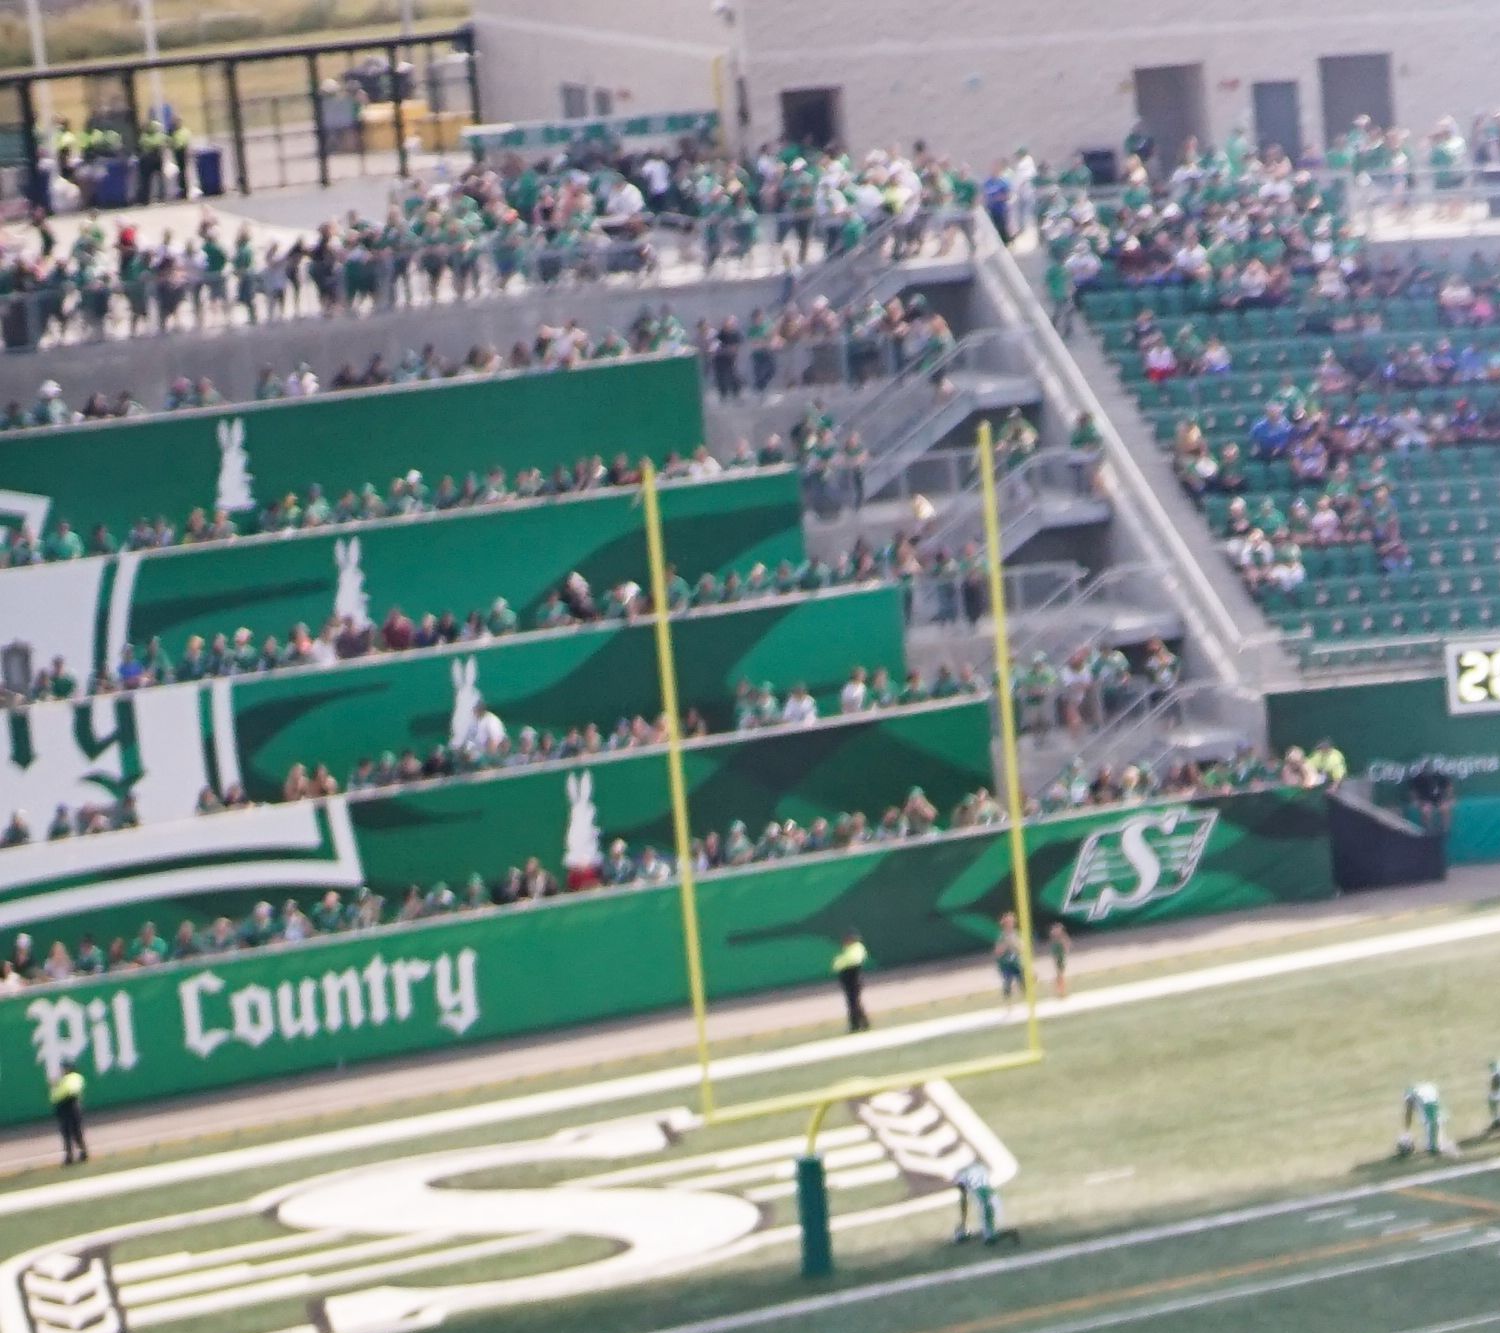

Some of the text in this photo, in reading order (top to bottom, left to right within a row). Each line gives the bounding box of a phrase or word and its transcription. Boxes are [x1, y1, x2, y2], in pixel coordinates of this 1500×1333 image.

[1435, 754, 1500, 781] Regina
[26, 947, 480, 1092] Pil Country
